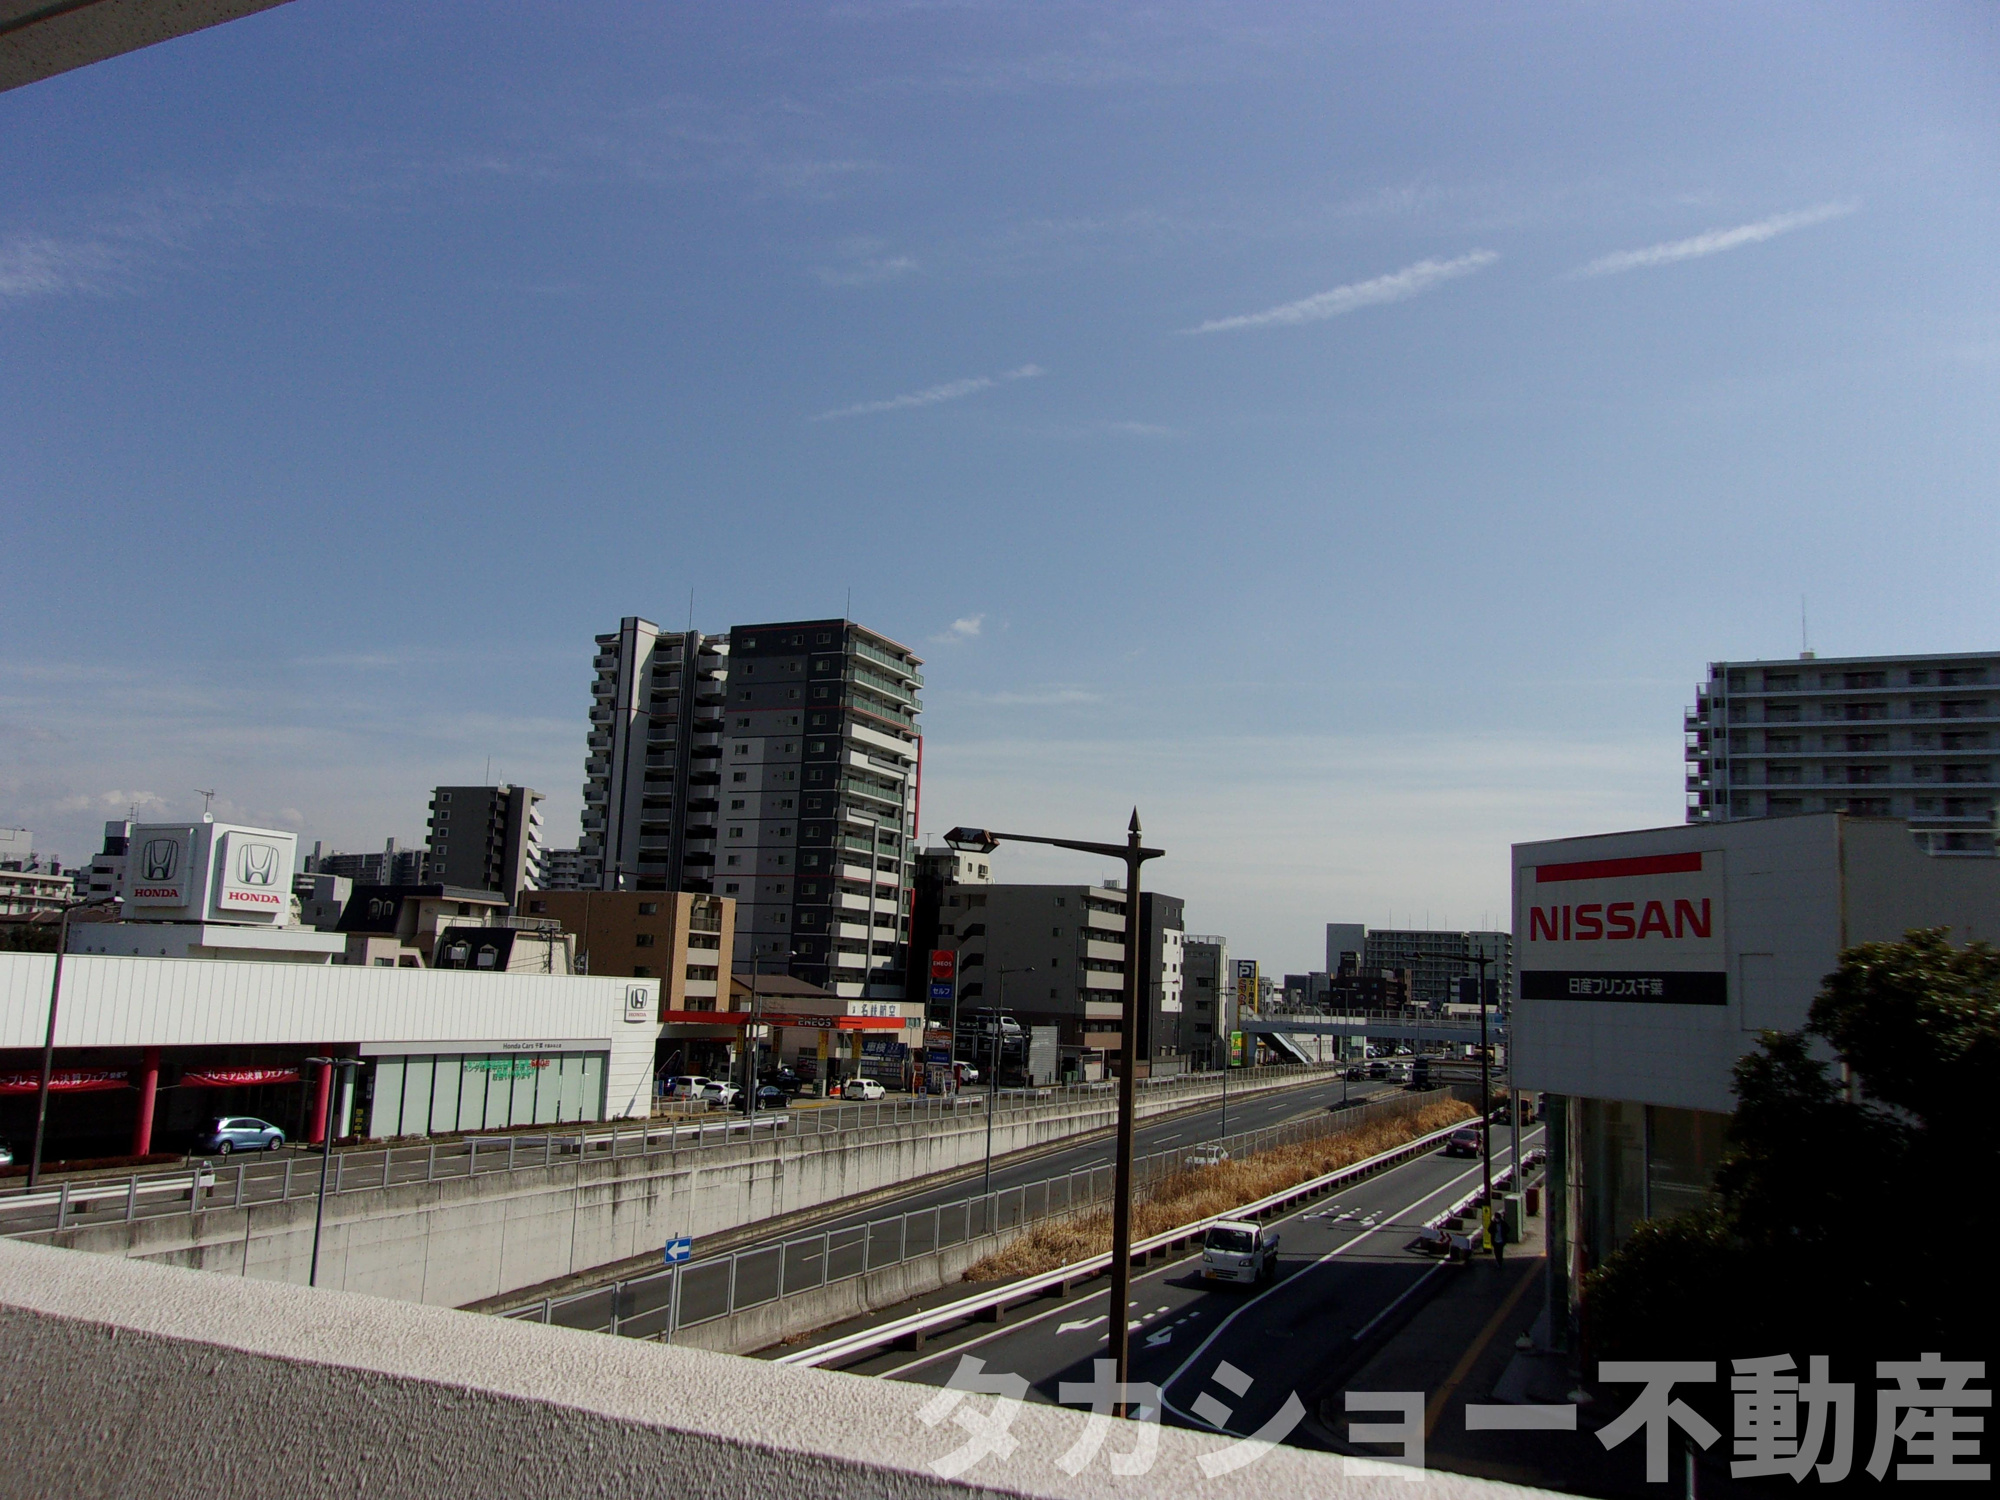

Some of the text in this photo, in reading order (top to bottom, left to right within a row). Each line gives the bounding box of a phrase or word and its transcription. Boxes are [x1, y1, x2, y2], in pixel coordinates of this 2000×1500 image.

[134, 889, 179, 898] HONDA
[228, 892, 281, 904] HONDA
[1530, 898, 1712, 942] NISSAN
[1569, 978, 1664, 996] 日産プリンス千葉
[798, 1018, 832, 1028] ENEOS
